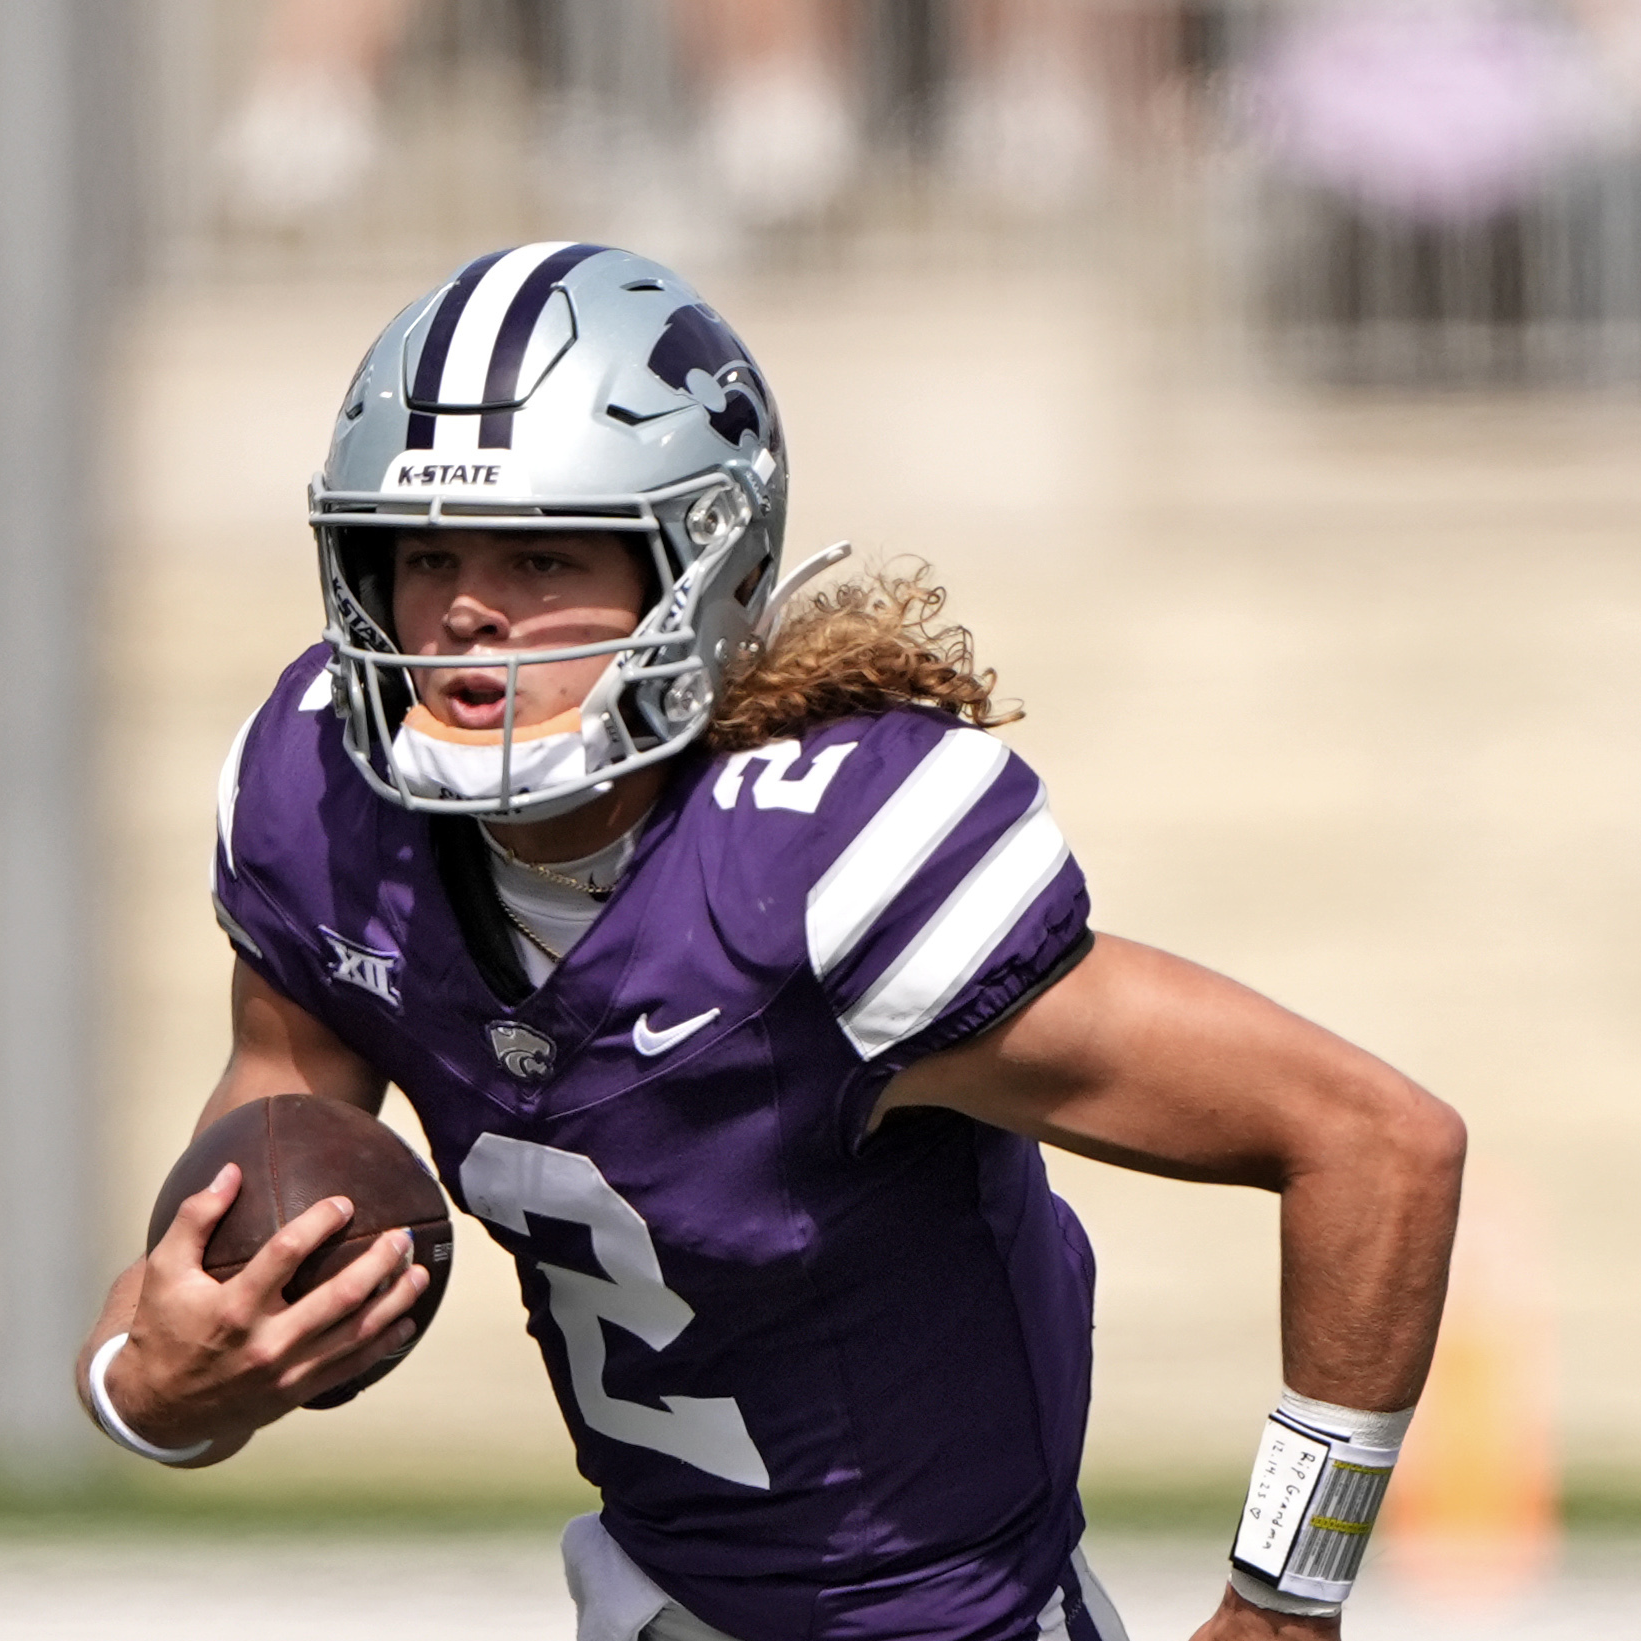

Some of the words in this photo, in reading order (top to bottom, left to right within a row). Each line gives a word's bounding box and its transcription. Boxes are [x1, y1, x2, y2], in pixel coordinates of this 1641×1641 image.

[397, 464, 501, 486] K-STATE
[332, 576, 393, 653] K-STAT
[712, 738, 859, 815] 2
[322, 934, 399, 1008] XII
[460, 1131, 771, 1491] 2
[1262, 1484, 1301, 1550] Grandma
